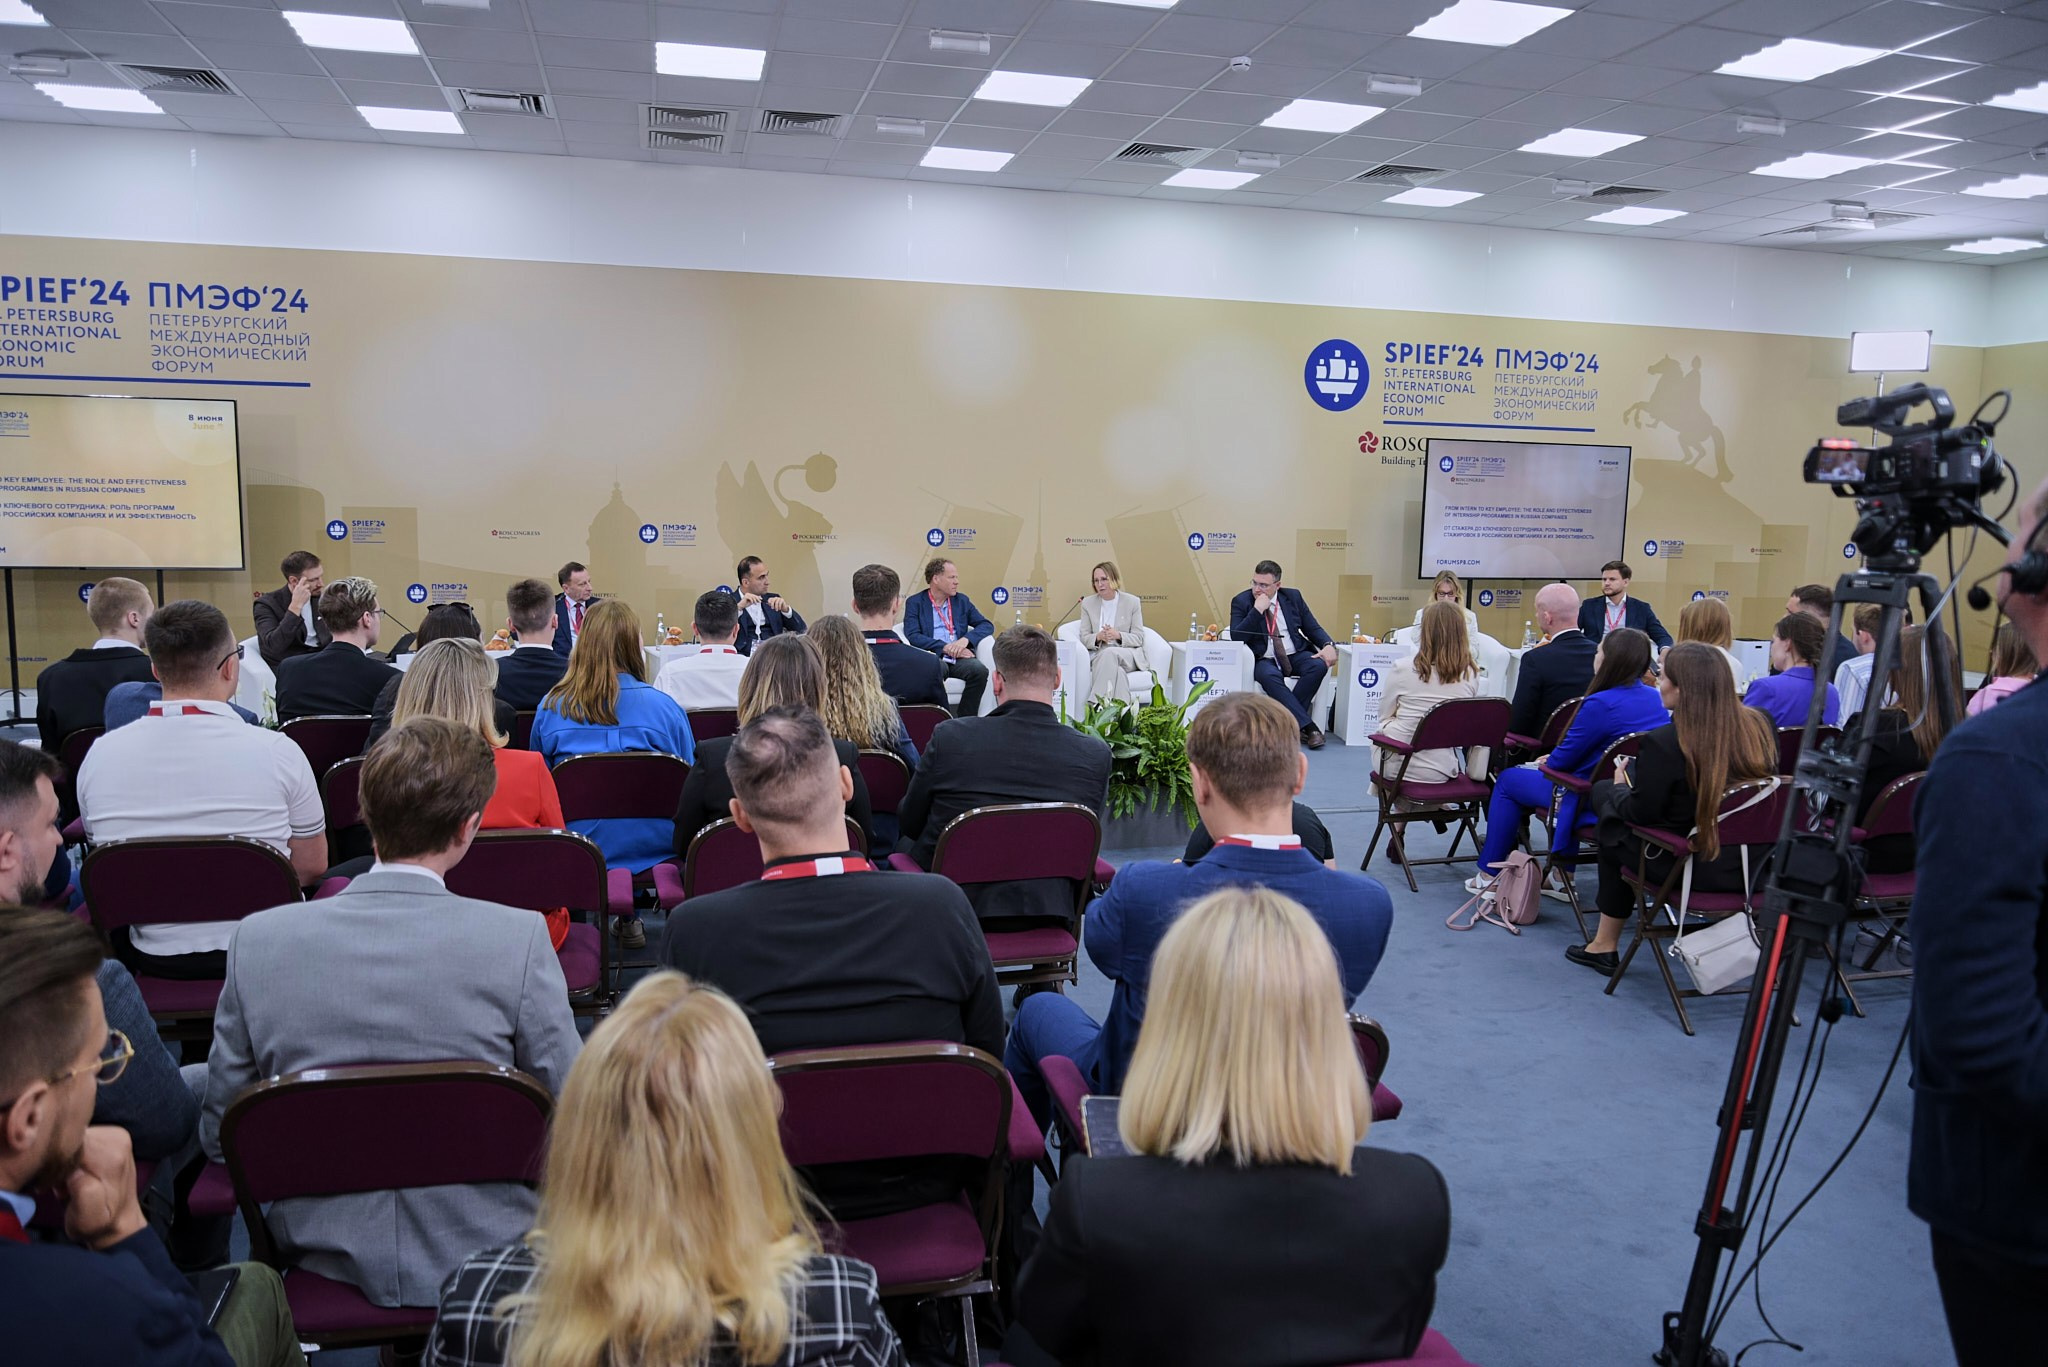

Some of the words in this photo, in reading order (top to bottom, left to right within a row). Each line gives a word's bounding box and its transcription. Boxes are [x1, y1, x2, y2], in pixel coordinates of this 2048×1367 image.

[0, 276, 130, 306] PIEF‘24
[7, 308, 114, 324] PETERSBURG
[150, 314, 287, 330] ПЕТЕРБУРГСКИЙ
[0, 324, 121, 339] TERNATIONAL
[150, 330, 310, 347] МЕЖДУНАРОДНЫЙ
[0, 339, 76, 353] ONOMIC
[151, 345, 307, 361] ЭКОНОМИЧЕСКИЙ
[0, 355, 44, 368] RUM
[151, 361, 213, 373] ФОРУМ
[1384, 367, 1399, 378] ST.
[1402, 368, 1472, 381] PETERSBURG
[1495, 373, 1584, 387] ПЕТЕРБУРГСКИЙ
[1384, 381, 1476, 394] INTERNATIONAL
[1494, 386, 1598, 399] МЕЖДУНАРОДНЫЙ
[1383, 393, 1445, 405] ECONOMIC
[1494, 398, 1595, 411] ЭКОНОМИЧЕСКИЙ
[0, 411, 29, 419] ЭФ'24
[1383, 406, 1424, 416] FORUM
[1493, 410, 1534, 421] ФОРУМ
[1381, 456, 1416, 468] Building
[55, 503, 108, 511] СОТРУДНИКА:
